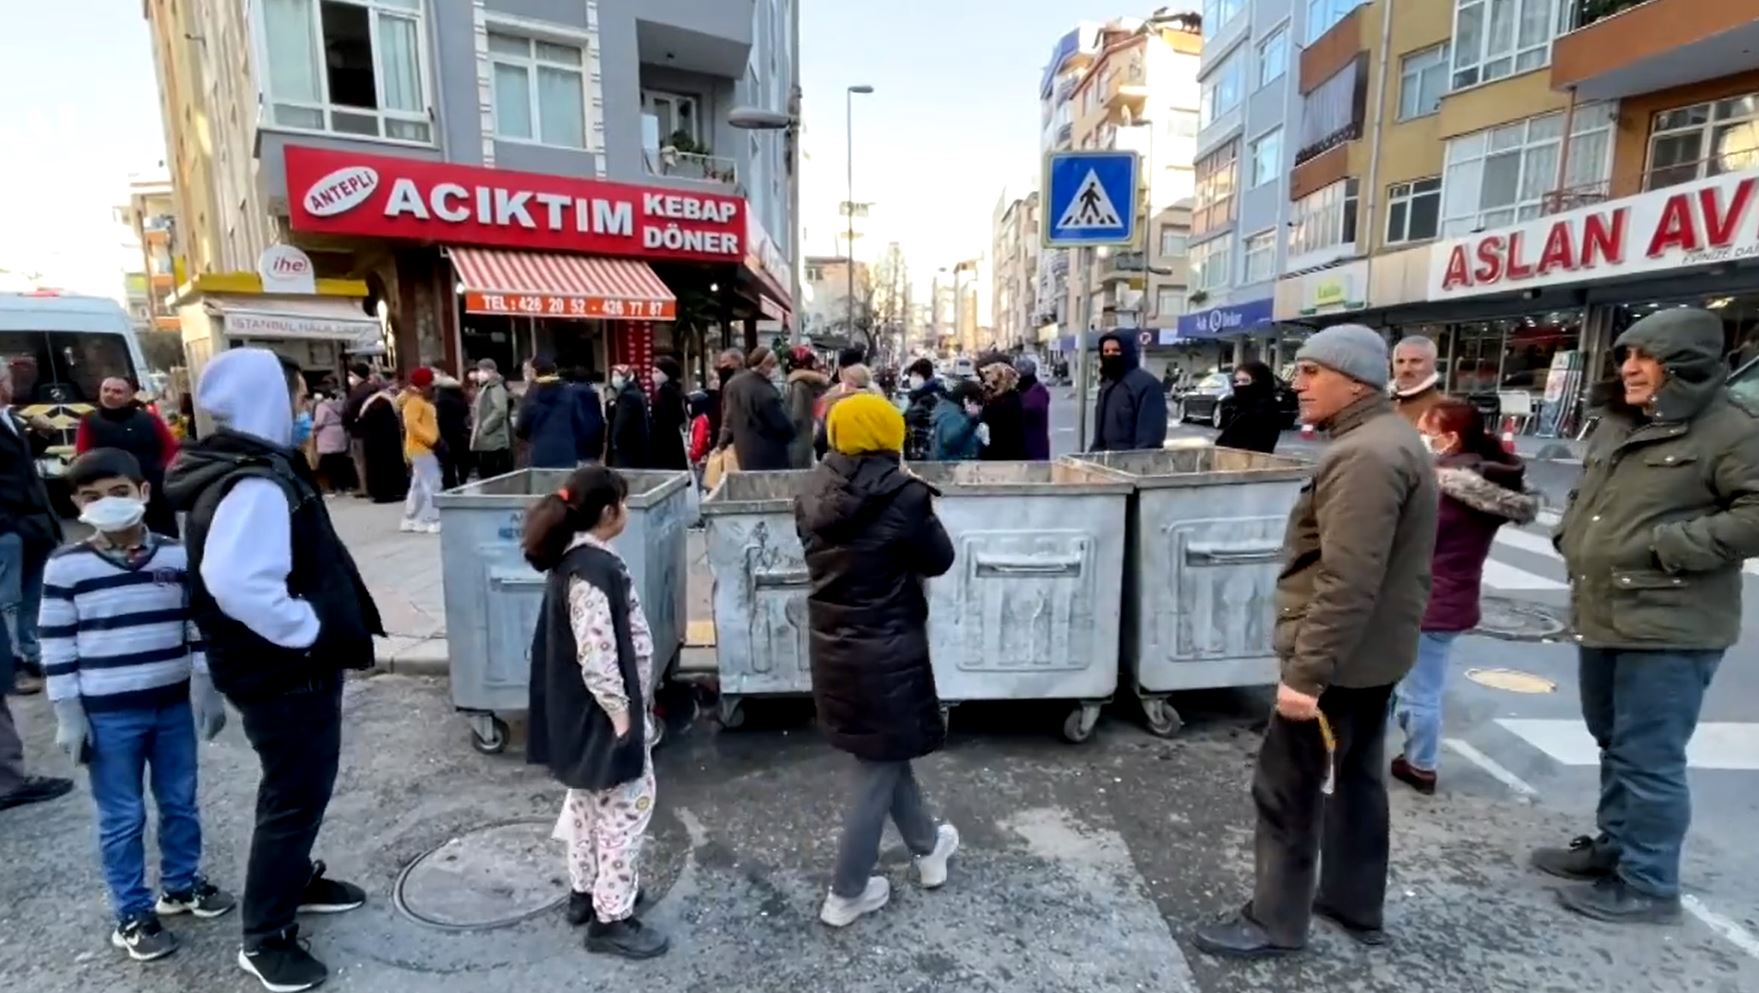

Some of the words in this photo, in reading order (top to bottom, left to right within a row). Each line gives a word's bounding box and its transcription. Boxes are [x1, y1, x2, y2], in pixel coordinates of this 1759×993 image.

[309, 170, 375, 212] ANTEPLİ
[383, 177, 634, 237] ACIKTIM
[643, 192, 737, 222] KEBAP
[643, 223, 739, 254] DÖNER
[1442, 208, 1632, 291] ASLAN
[1645, 177, 1759, 258] AV
[549, 297, 564, 314] 20
[570, 298, 586, 315] 52
[602, 299, 624, 316] 426
[629, 301, 643, 316] 77
[650, 301, 663, 317] 87
